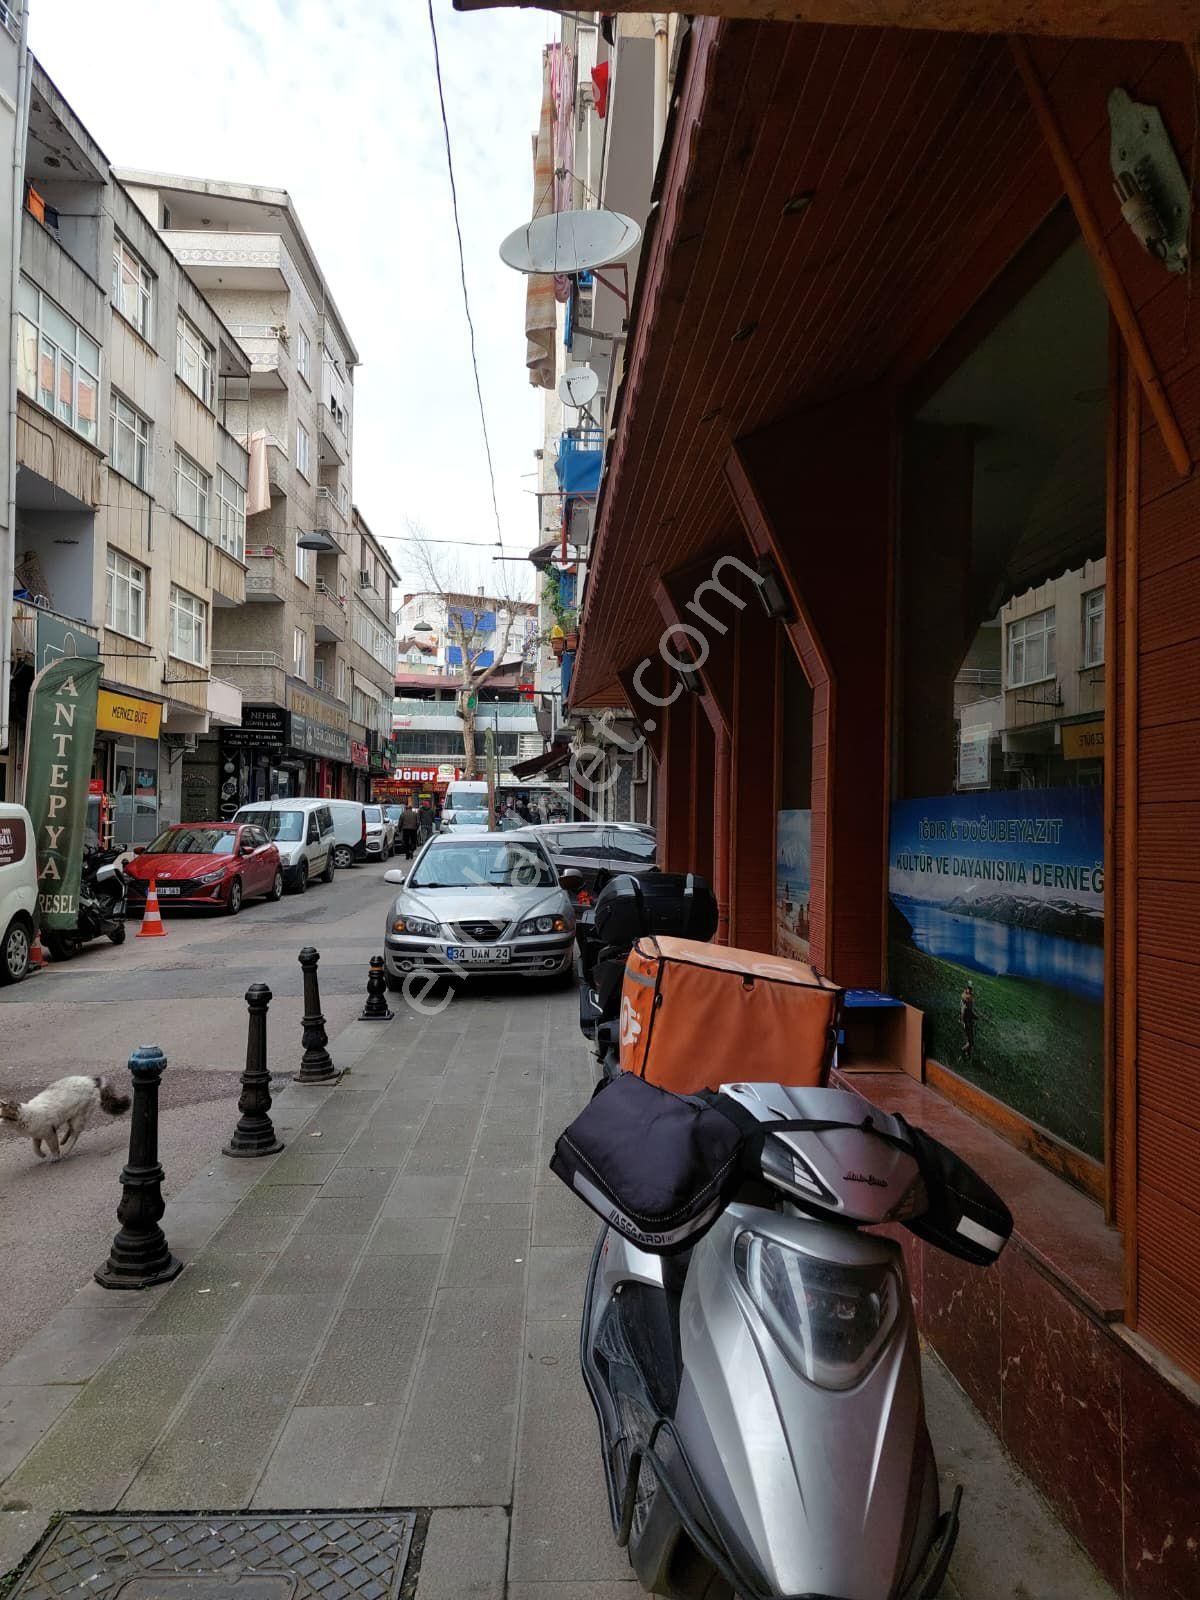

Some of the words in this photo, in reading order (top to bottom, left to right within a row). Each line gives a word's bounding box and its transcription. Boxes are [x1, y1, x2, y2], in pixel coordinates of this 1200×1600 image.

[112, 705, 134, 722] MERKEZ
[39, 675, 79, 880] ANTEPYA
[394, 768, 436, 781] Döner
[962, 814, 1063, 845] DOĞUBEYAZIT
[897, 847, 933, 874] KÜLTÜR
[936, 856, 949, 875] VE
[953, 857, 1027, 885] DAYANIŞMA
[1032, 861, 1104, 894] DERNEĞ
[453, 949, 465, 960] 34
[495, 948, 508, 959] 24
